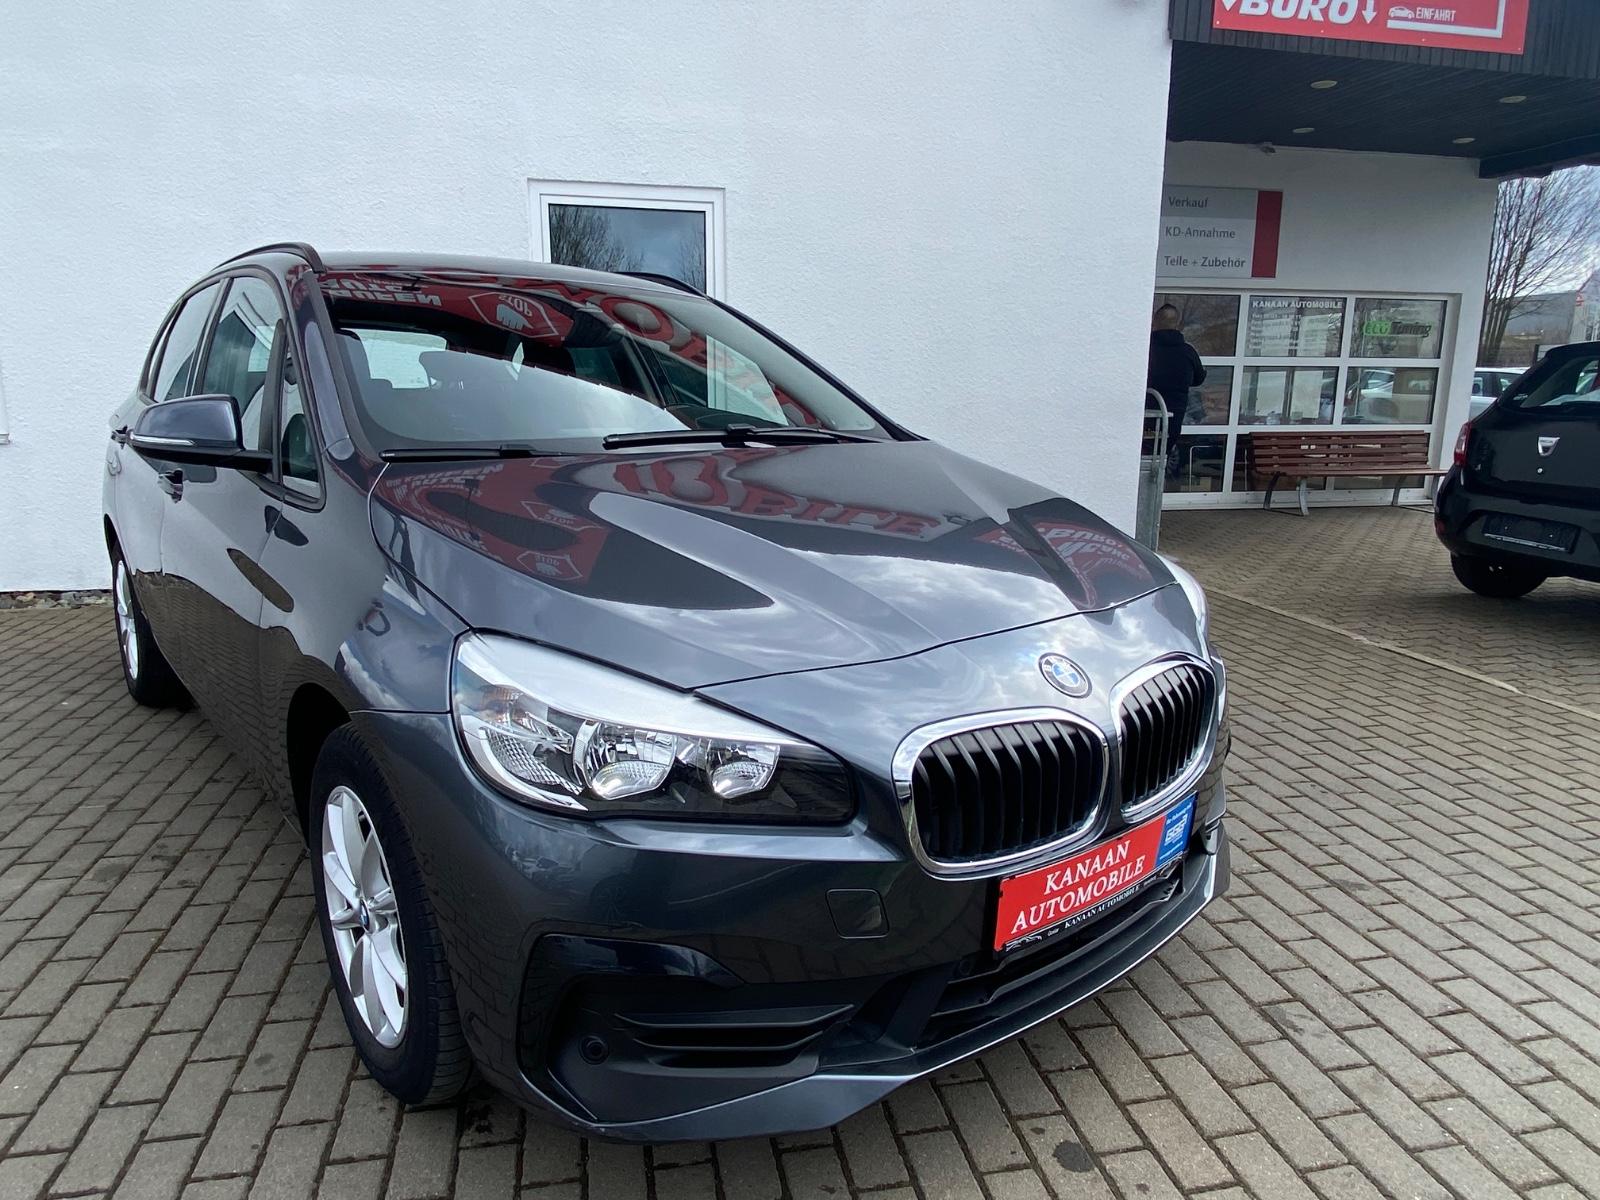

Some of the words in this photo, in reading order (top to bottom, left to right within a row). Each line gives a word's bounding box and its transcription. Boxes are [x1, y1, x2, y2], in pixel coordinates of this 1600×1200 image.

[1416, 7, 1456, 22] EINFAHRT
[1168, 197, 1208, 208] Verkauf
[1165, 226, 1236, 239] KD-Annahme
[1164, 256, 1188, 267] Teile
[1201, 256, 1246, 268] Zubehör
[1252, 300, 1288, 308] KANAAN
[1291, 301, 1343, 309] AUTOMOBILE
[1044, 840, 1131, 895] KANAAN
[1011, 855, 1146, 934] AUTOMOBILE
[1064, 909, 1097, 929] KANAAN
[1096, 884, 1141, 912] AUTOMOBILE
